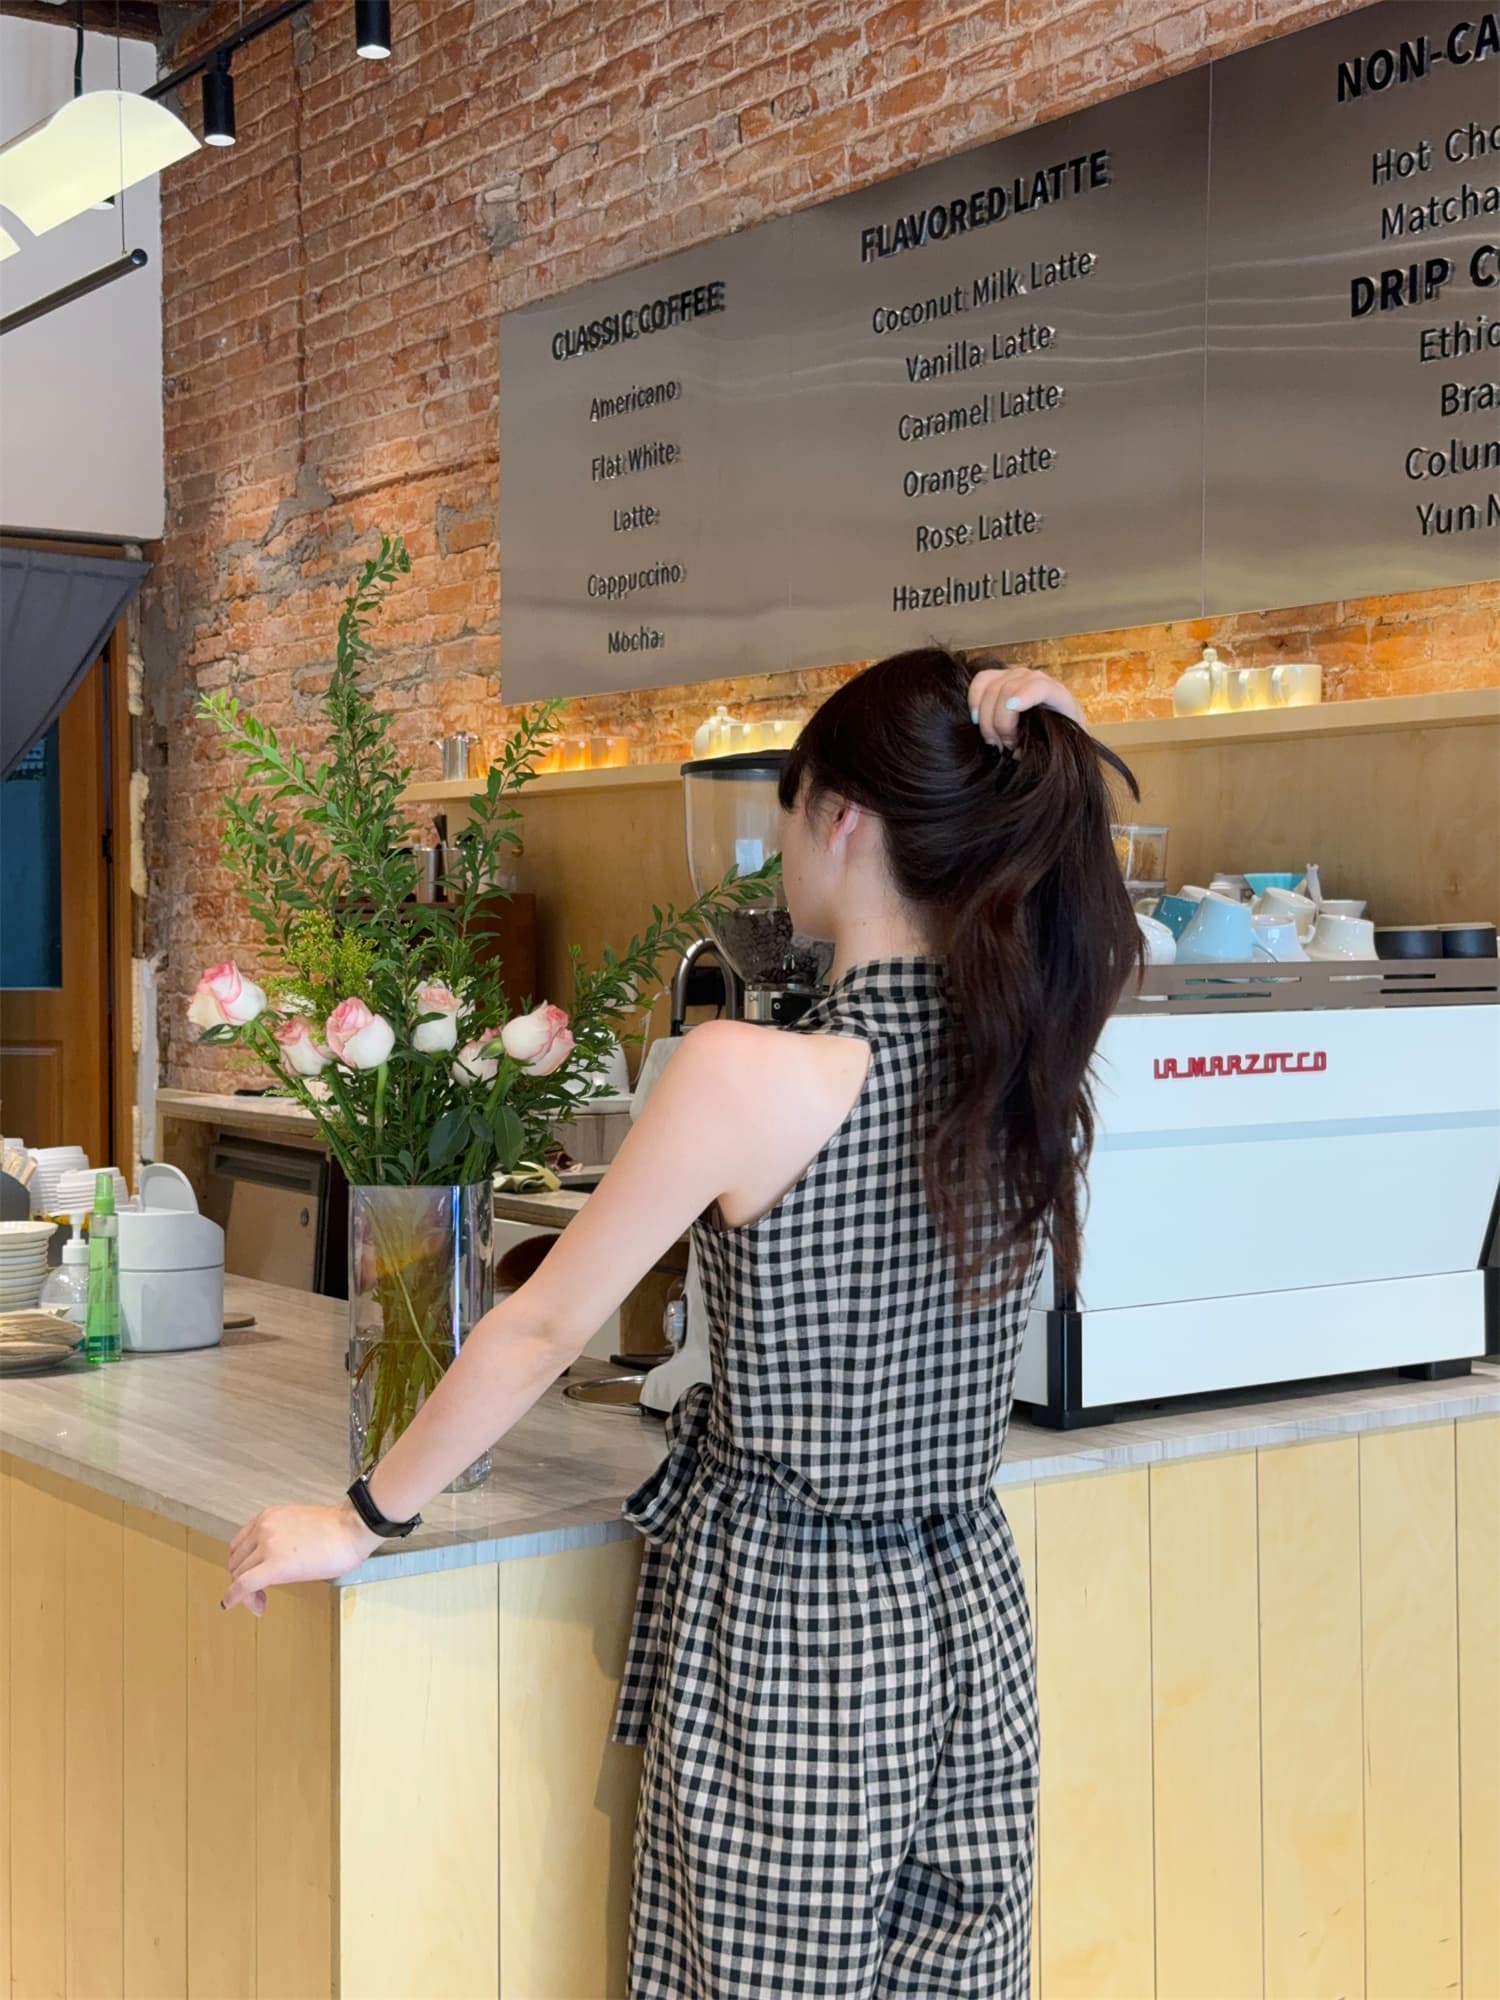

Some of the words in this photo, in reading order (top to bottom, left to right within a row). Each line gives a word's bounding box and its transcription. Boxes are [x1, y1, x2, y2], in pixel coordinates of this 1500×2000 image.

[1337, 14, 1500, 102] NON-CA
[1372, 140, 1429, 185] Hot
[861, 186, 1007, 262] FLAVORED
[1014, 150, 1108, 212] LATTE
[1381, 184, 1499, 240] Matcha
[873, 286, 962, 334] Coconut
[973, 266, 1020, 307] Milk
[1031, 252, 1092, 290] Latte
[1351, 257, 1450, 318] DRIP
[1469, 244, 1500, 288] C
[552, 310, 634, 360] CLASSIC
[639, 281, 724, 332] COFFEE
[906, 339, 981, 382] Vanilla
[993, 324, 1052, 361] Latte
[589, 379, 677, 421] Americano
[899, 395, 988, 441] Caramel
[1001, 385, 1060, 419] Latte
[1441, 382, 1500, 417] Bra
[592, 454, 621, 481] Flat
[628, 442, 676, 472] White
[903, 463, 983, 497] Orange
[993, 447, 1052, 481] Latte
[614, 505, 655, 532] Latte
[917, 525, 967, 552] Rose
[979, 510, 1037, 541] Latte
[1416, 503, 1476, 537] Yun
[588, 561, 681, 600] Cappuccino
[893, 574, 991, 612] Hazelnut
[1001, 565, 1061, 596] Latte
[608, 626, 660, 654] Mocha
[1153, 1058, 1178, 1079] LA
